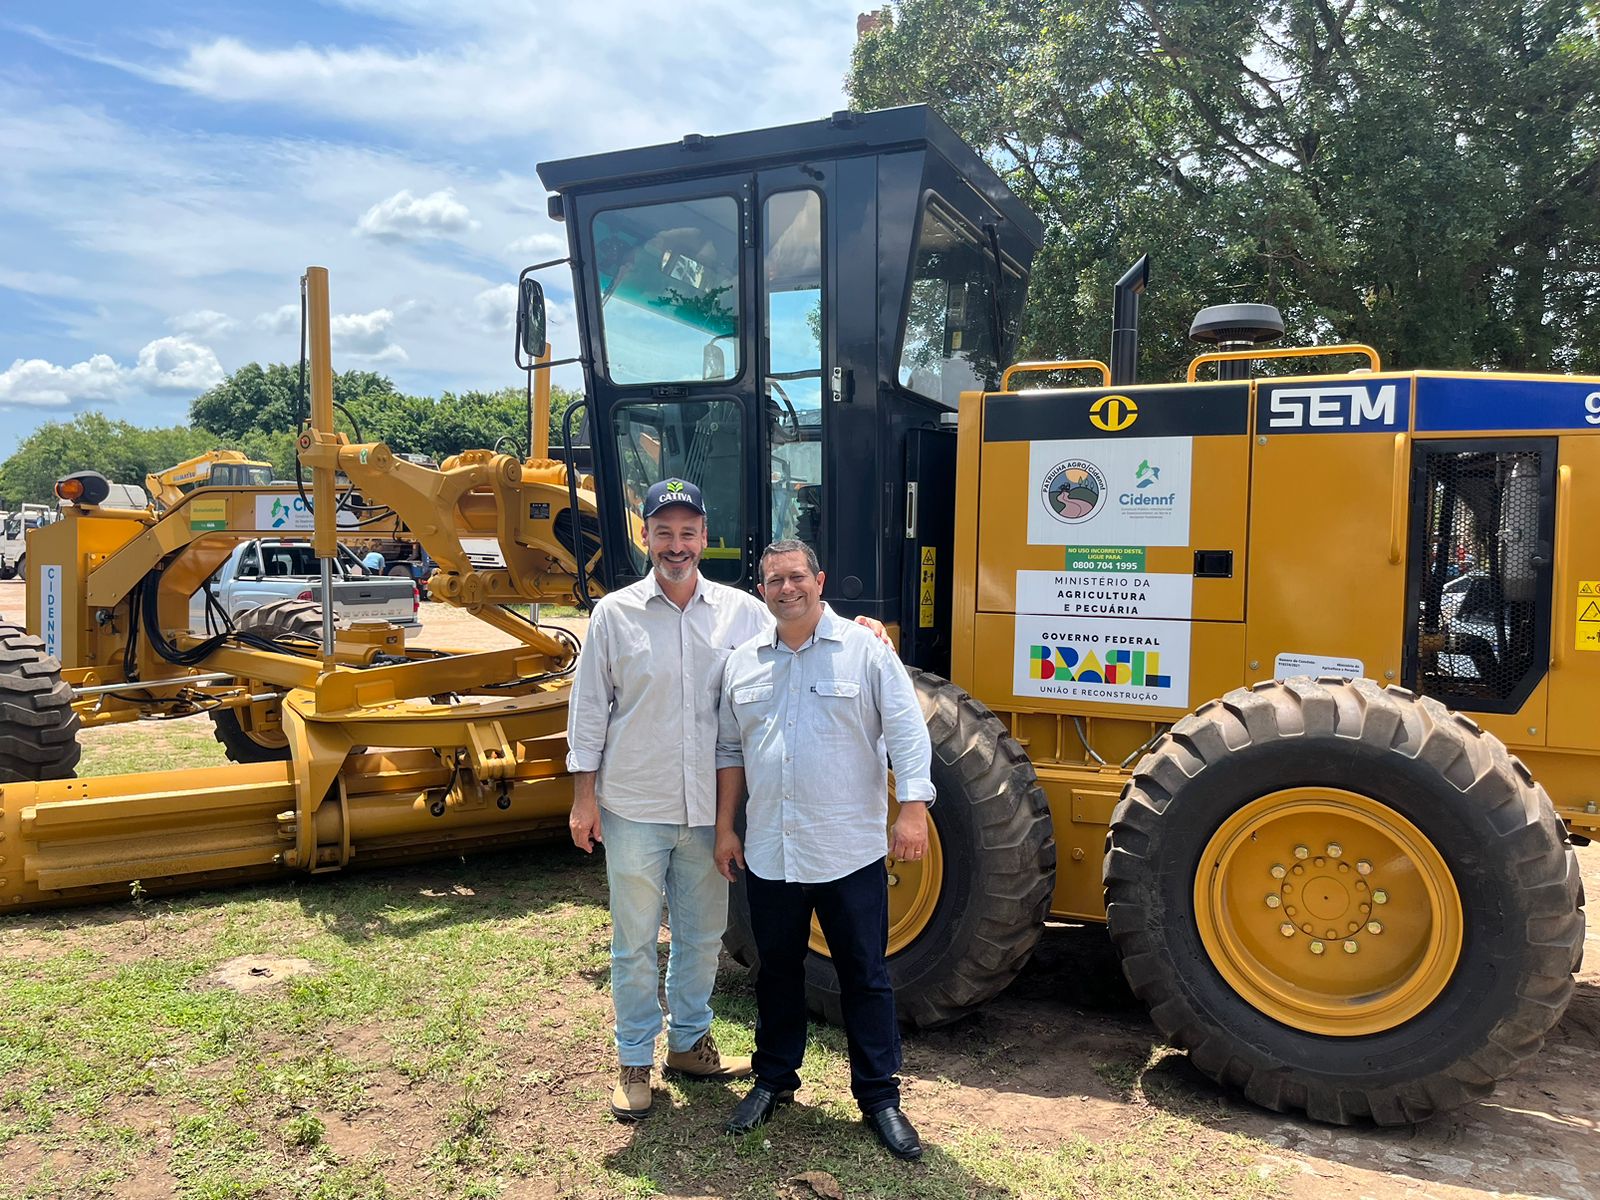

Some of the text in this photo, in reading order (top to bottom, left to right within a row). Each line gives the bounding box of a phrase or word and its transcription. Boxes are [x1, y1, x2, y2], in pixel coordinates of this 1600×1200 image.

[1269, 385, 1397, 428] SEM
[1043, 465, 1067, 493] PATRULHA
[659, 492, 693, 503] CATIVA
[1119, 493, 1176, 505] Cidennf
[1072, 561, 1137, 570] 0800 704 1995
[1054, 576, 1151, 588] MINISTÉRIO DA
[1057, 590, 1146, 601] AGRICULTURA
[1064, 603, 1139, 615] E PECUÁRIA
[1042, 632, 1160, 646] GOVERNO FEDERAL
[1029, 645, 1171, 688] BRASIL
[1040, 686, 1069, 695] UNIÃO
[1081, 689, 1158, 701] RECONSTRUÇÃO
